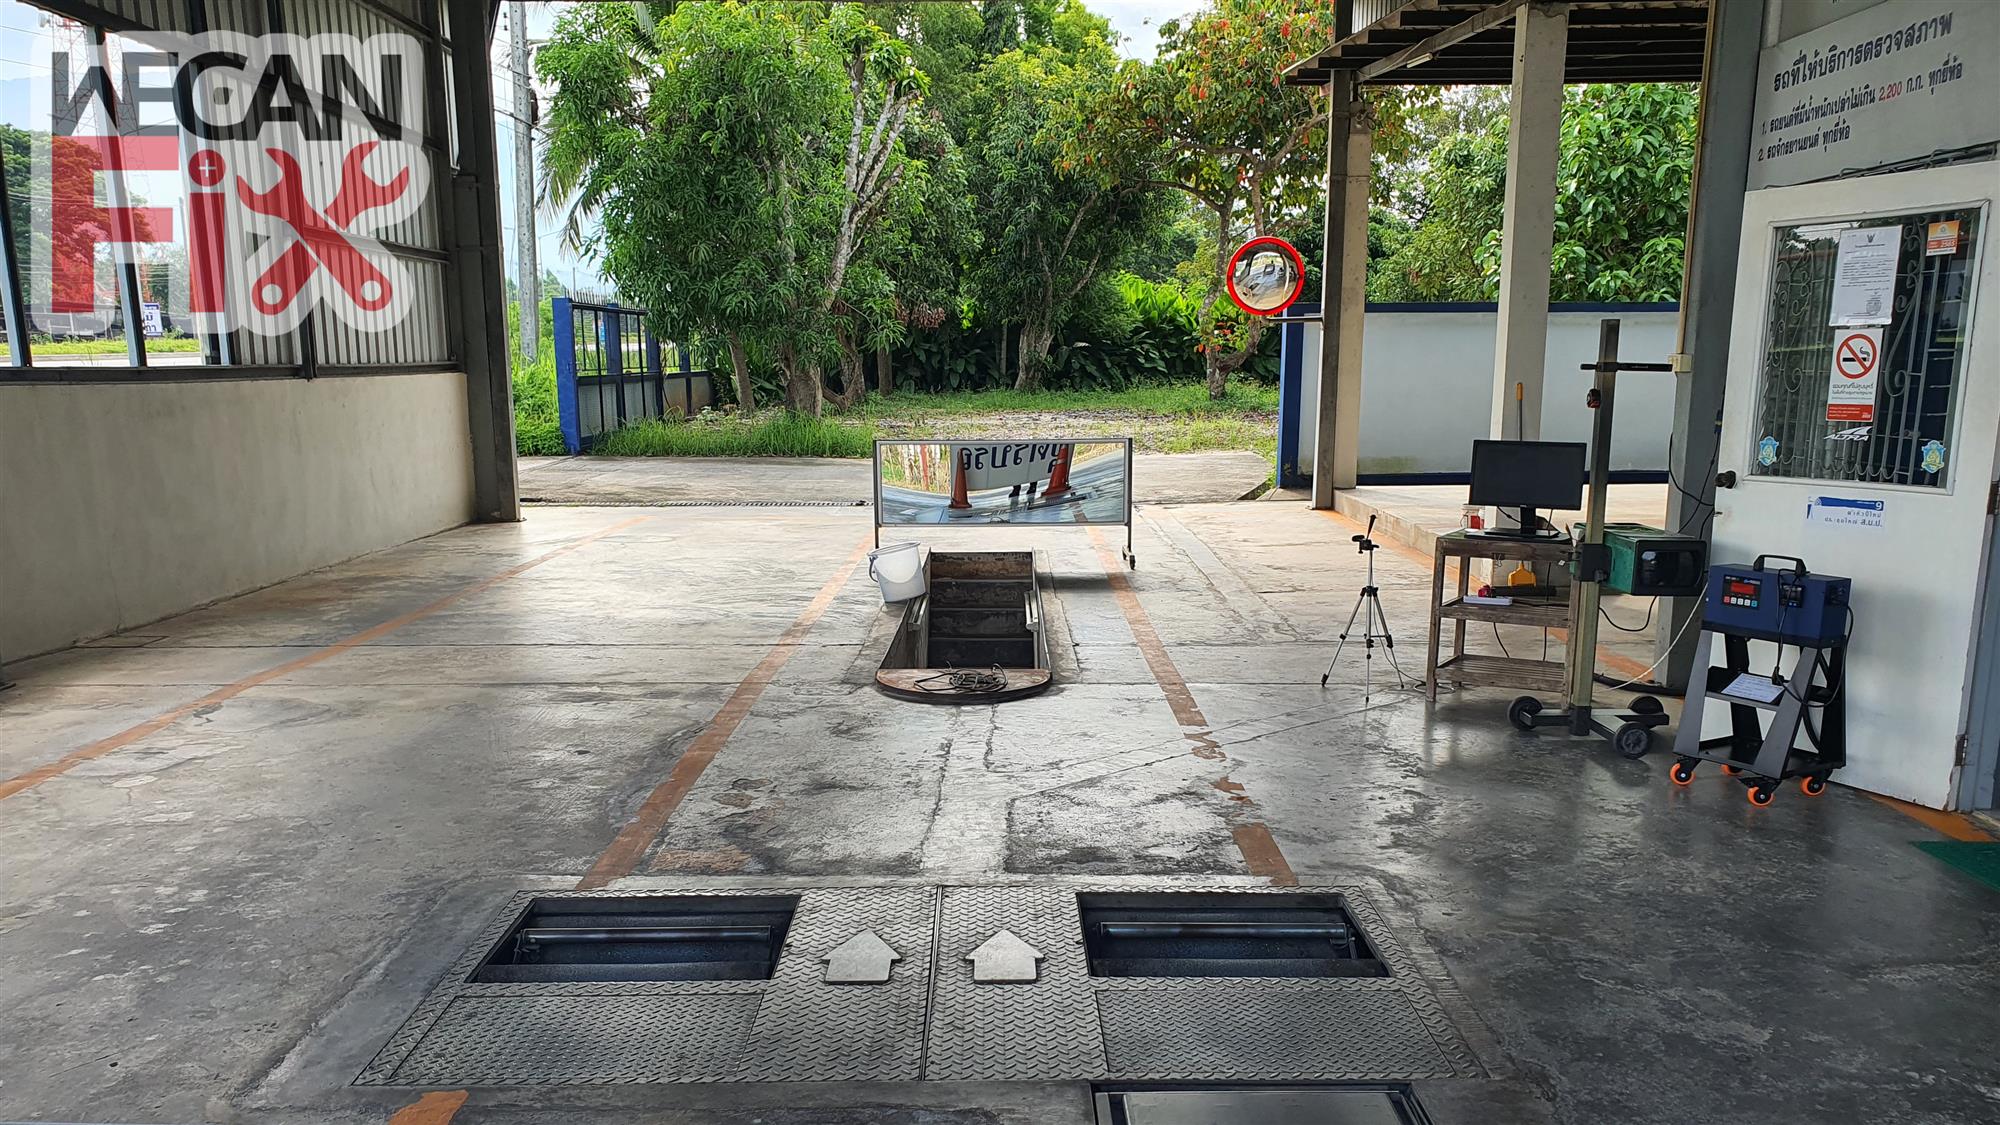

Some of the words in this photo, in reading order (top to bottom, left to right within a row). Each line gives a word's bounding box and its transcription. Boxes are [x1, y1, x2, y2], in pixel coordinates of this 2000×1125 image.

[1773, 12, 1952, 92] รถที่ให้บริการตรวจสภาพ
[1762, 121, 1768, 135] 1.
[1770, 83, 1876, 132] รถยนต์ที่มีน้ำหนักเปล่าไม่เกิน
[1928, 52, 1963, 96] ทุกยี่ห้อ
[1766, 126, 1821, 160] รถจักรยานยนต์
[1822, 115, 1851, 153] ทุกยี่ห้อ
[1823, 433, 1869, 442] ALTRA
[1875, 501, 1882, 511] 9
